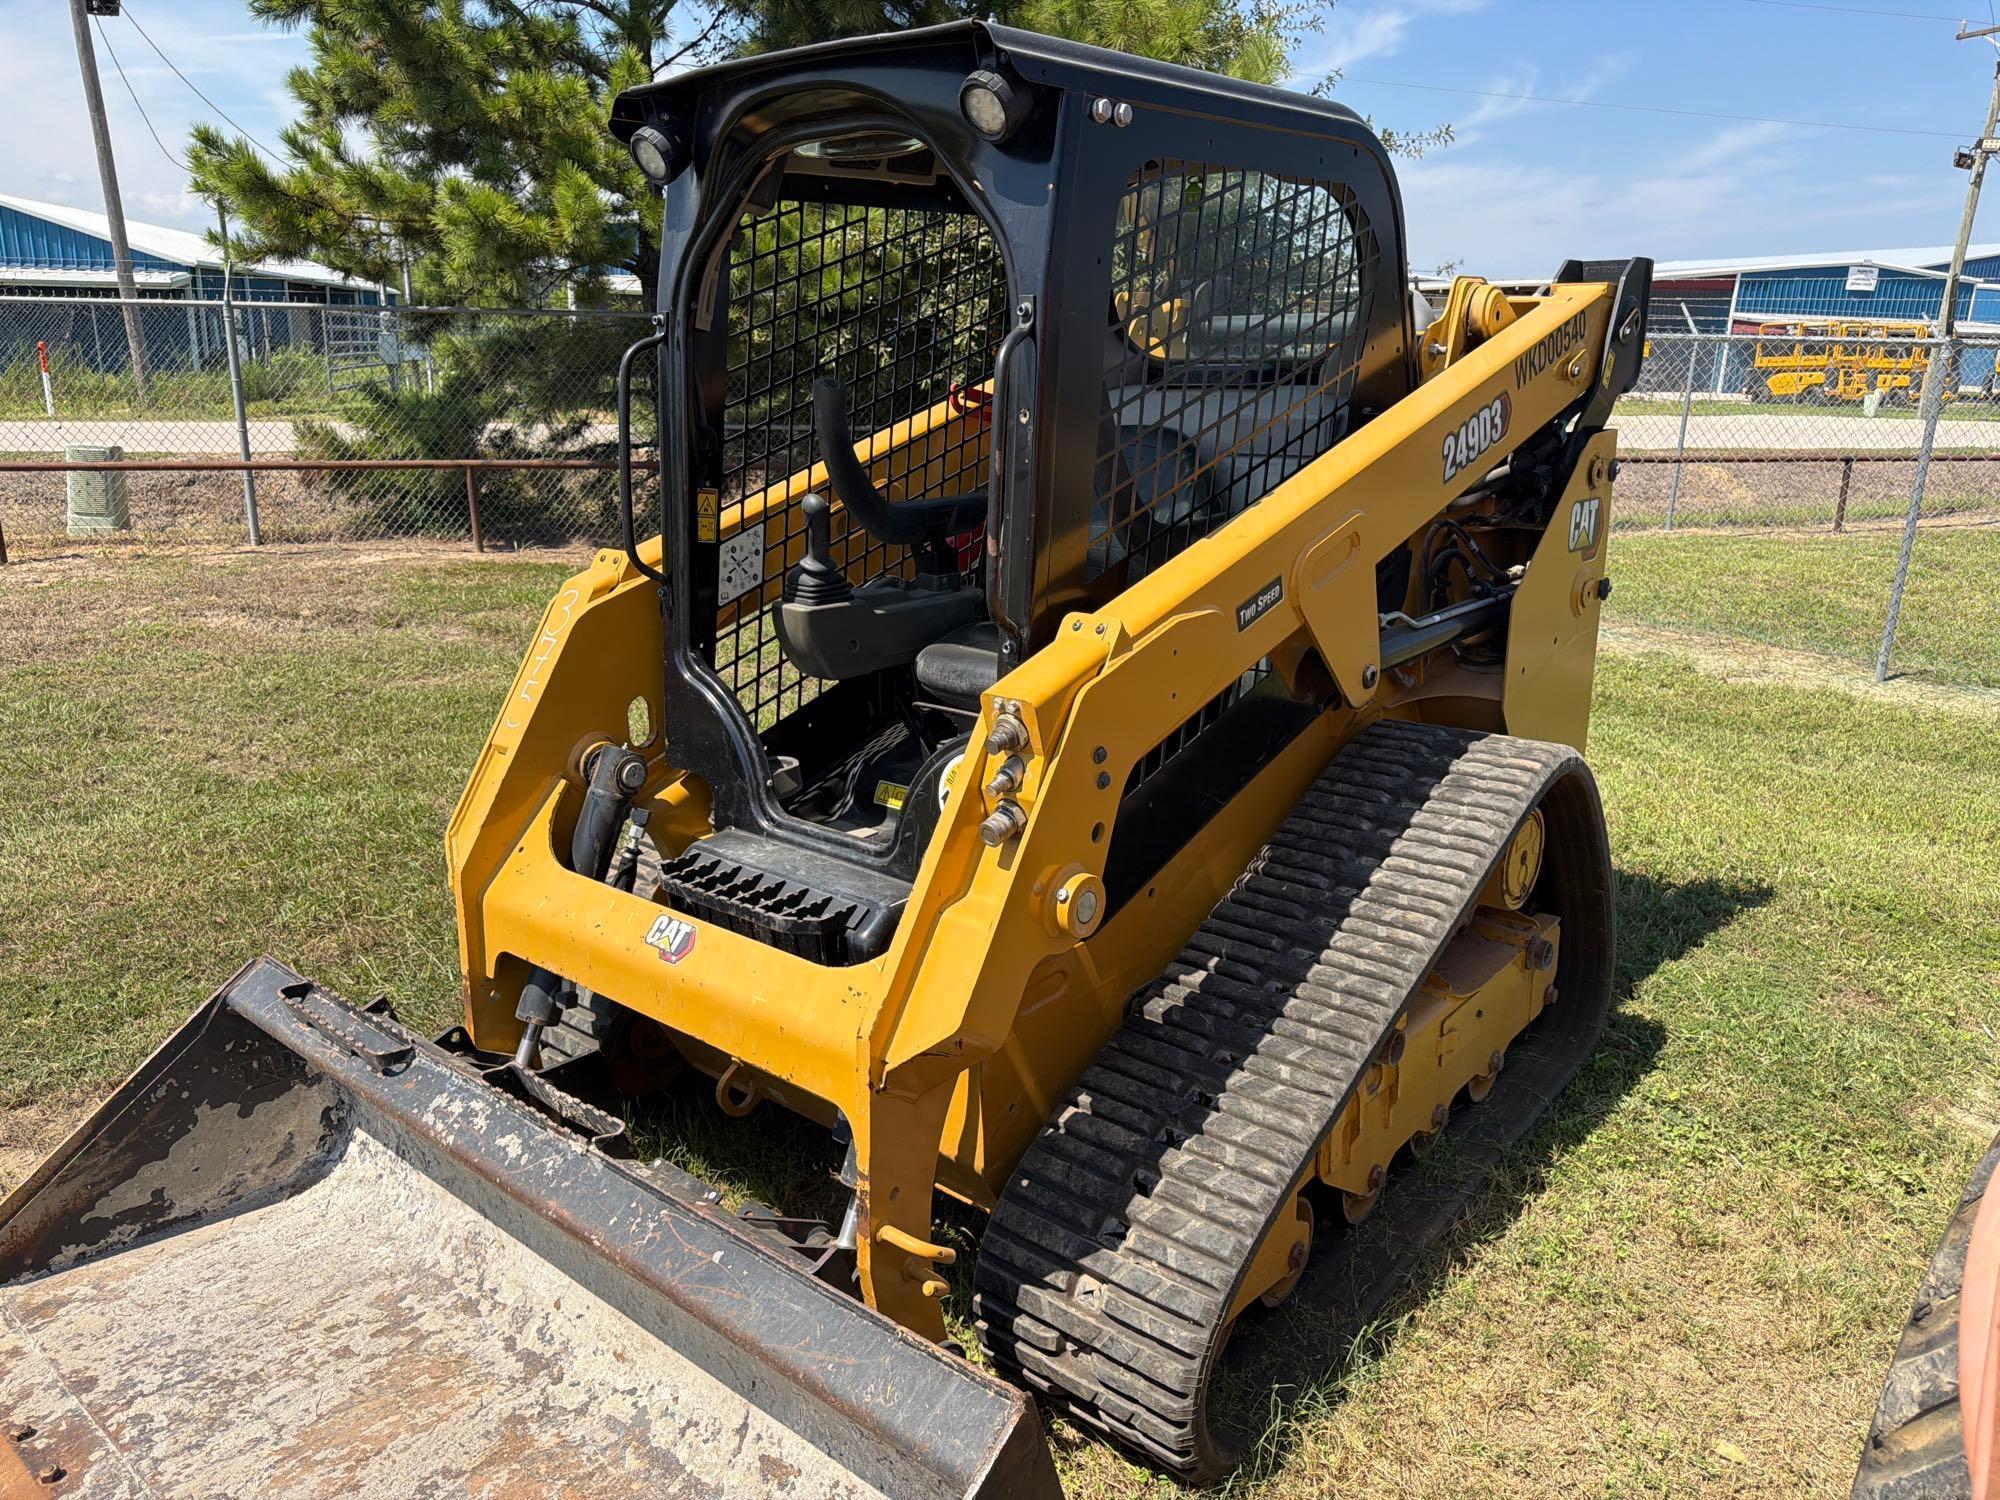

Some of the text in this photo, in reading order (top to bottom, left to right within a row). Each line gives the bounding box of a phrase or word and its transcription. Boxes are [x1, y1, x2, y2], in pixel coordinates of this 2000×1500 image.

[1514, 310, 1587, 390] WKD00540
[1443, 399, 1502, 482] 249D3
[1568, 498, 1600, 551] CAT
[645, 914, 696, 954] CAT
